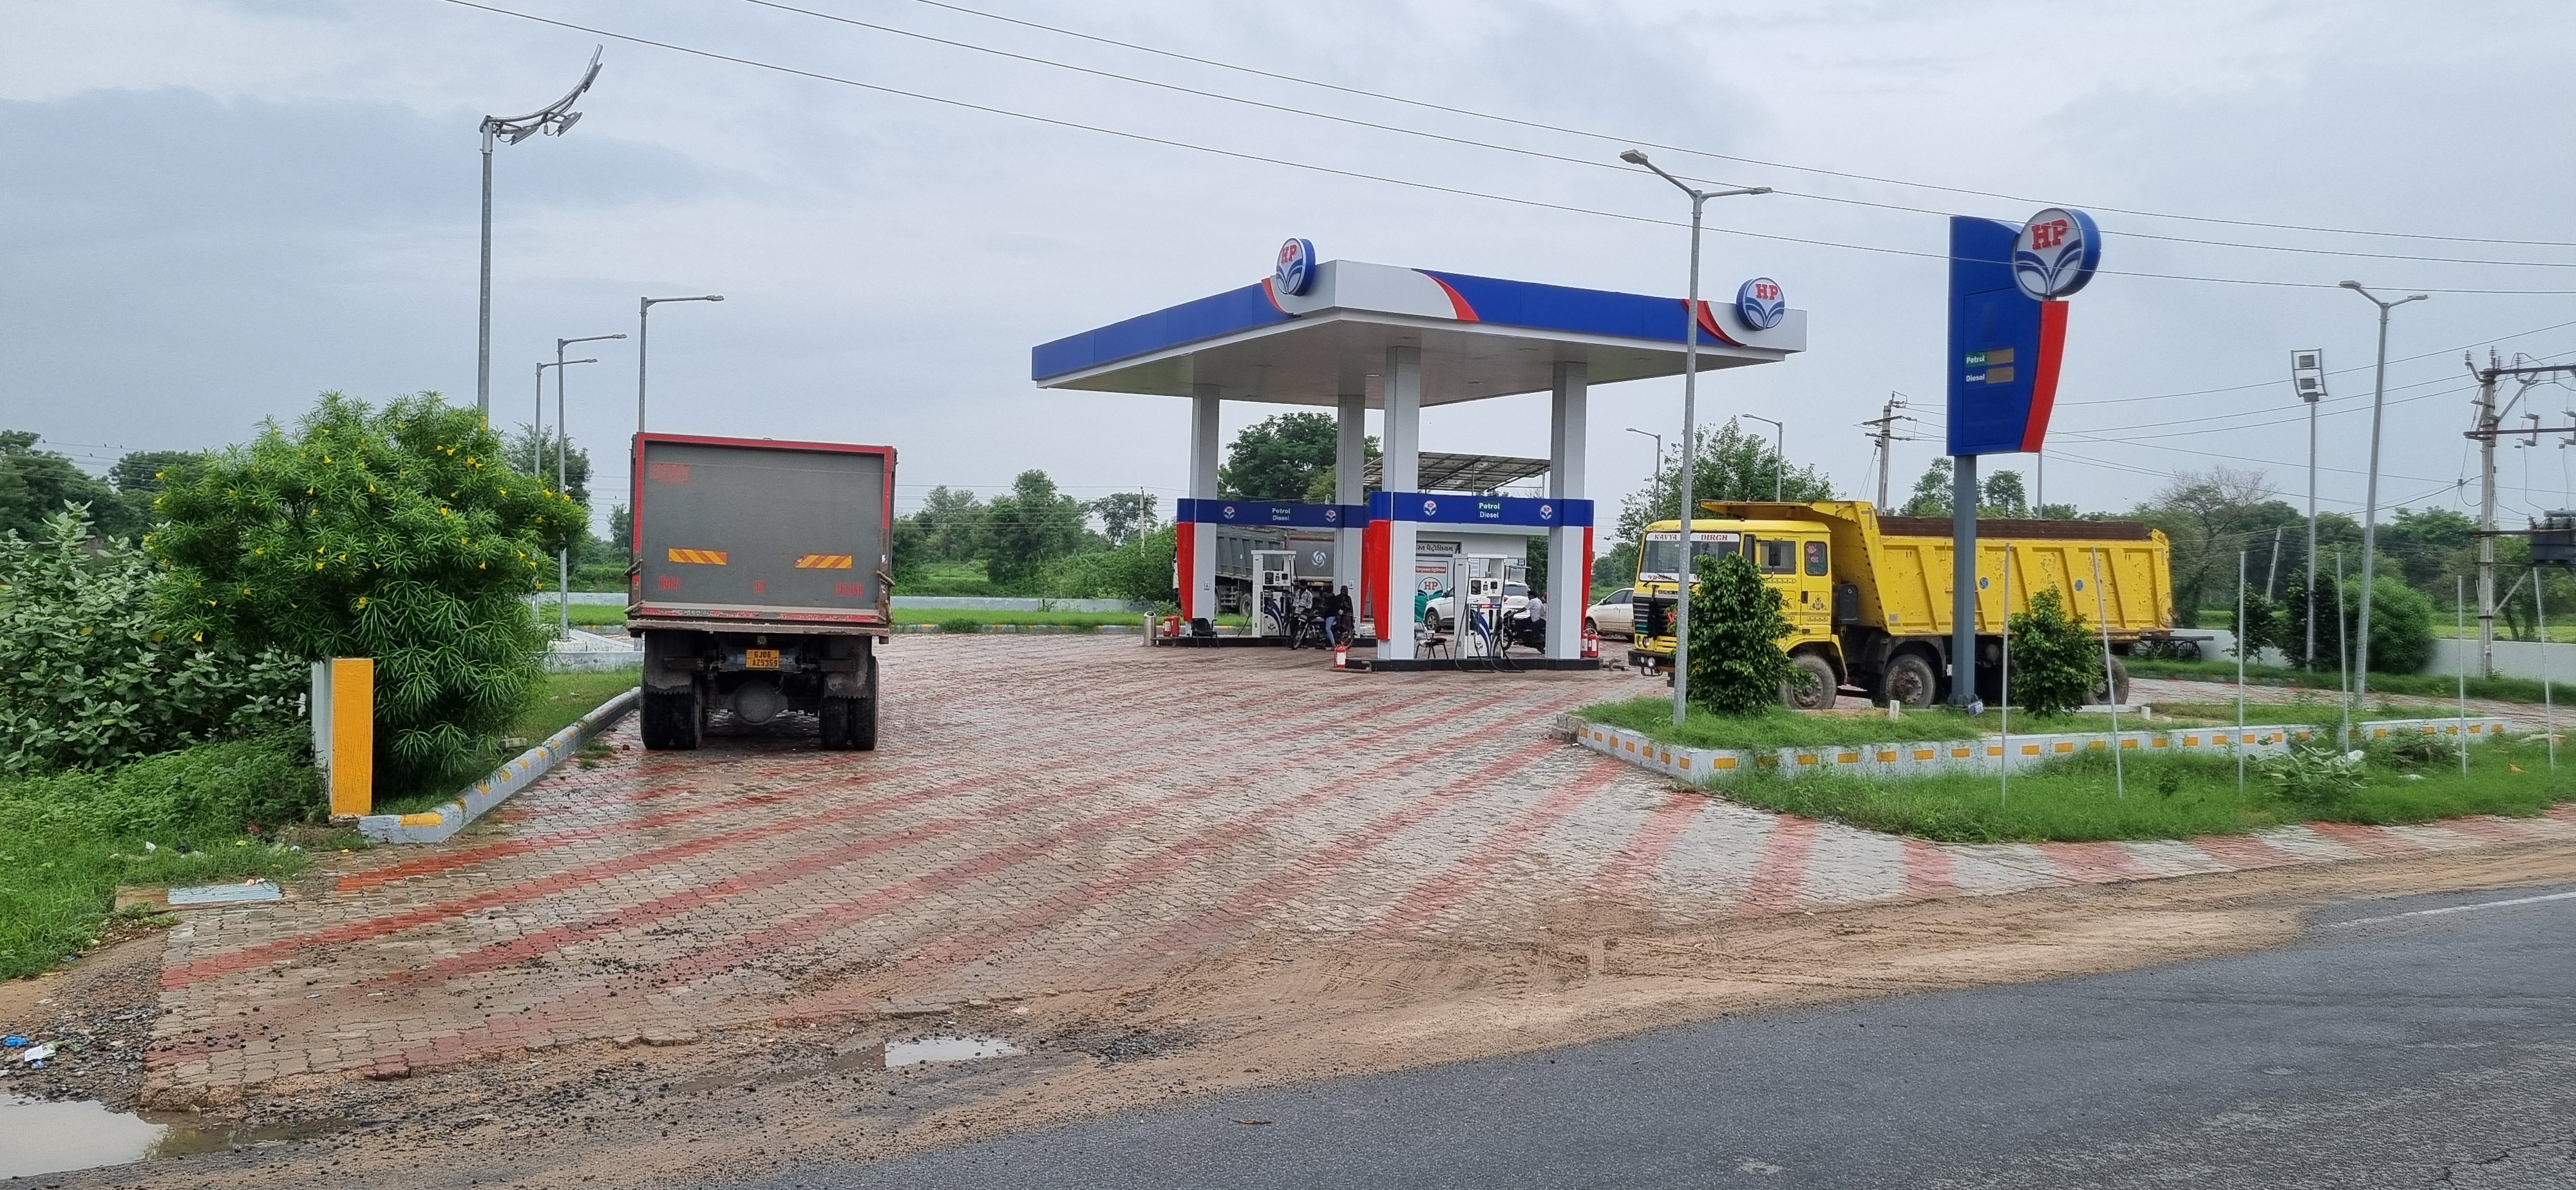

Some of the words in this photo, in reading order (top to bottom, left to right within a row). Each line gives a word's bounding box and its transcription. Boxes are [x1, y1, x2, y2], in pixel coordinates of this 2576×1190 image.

[2031, 218, 2068, 250] HP
[1281, 244, 1298, 264] HP
[1756, 283, 1779, 300] HP
[1966, 355, 1985, 364] Petrol
[1965, 373, 1985, 382] Diesel
[1424, 581, 1438, 590] HP
